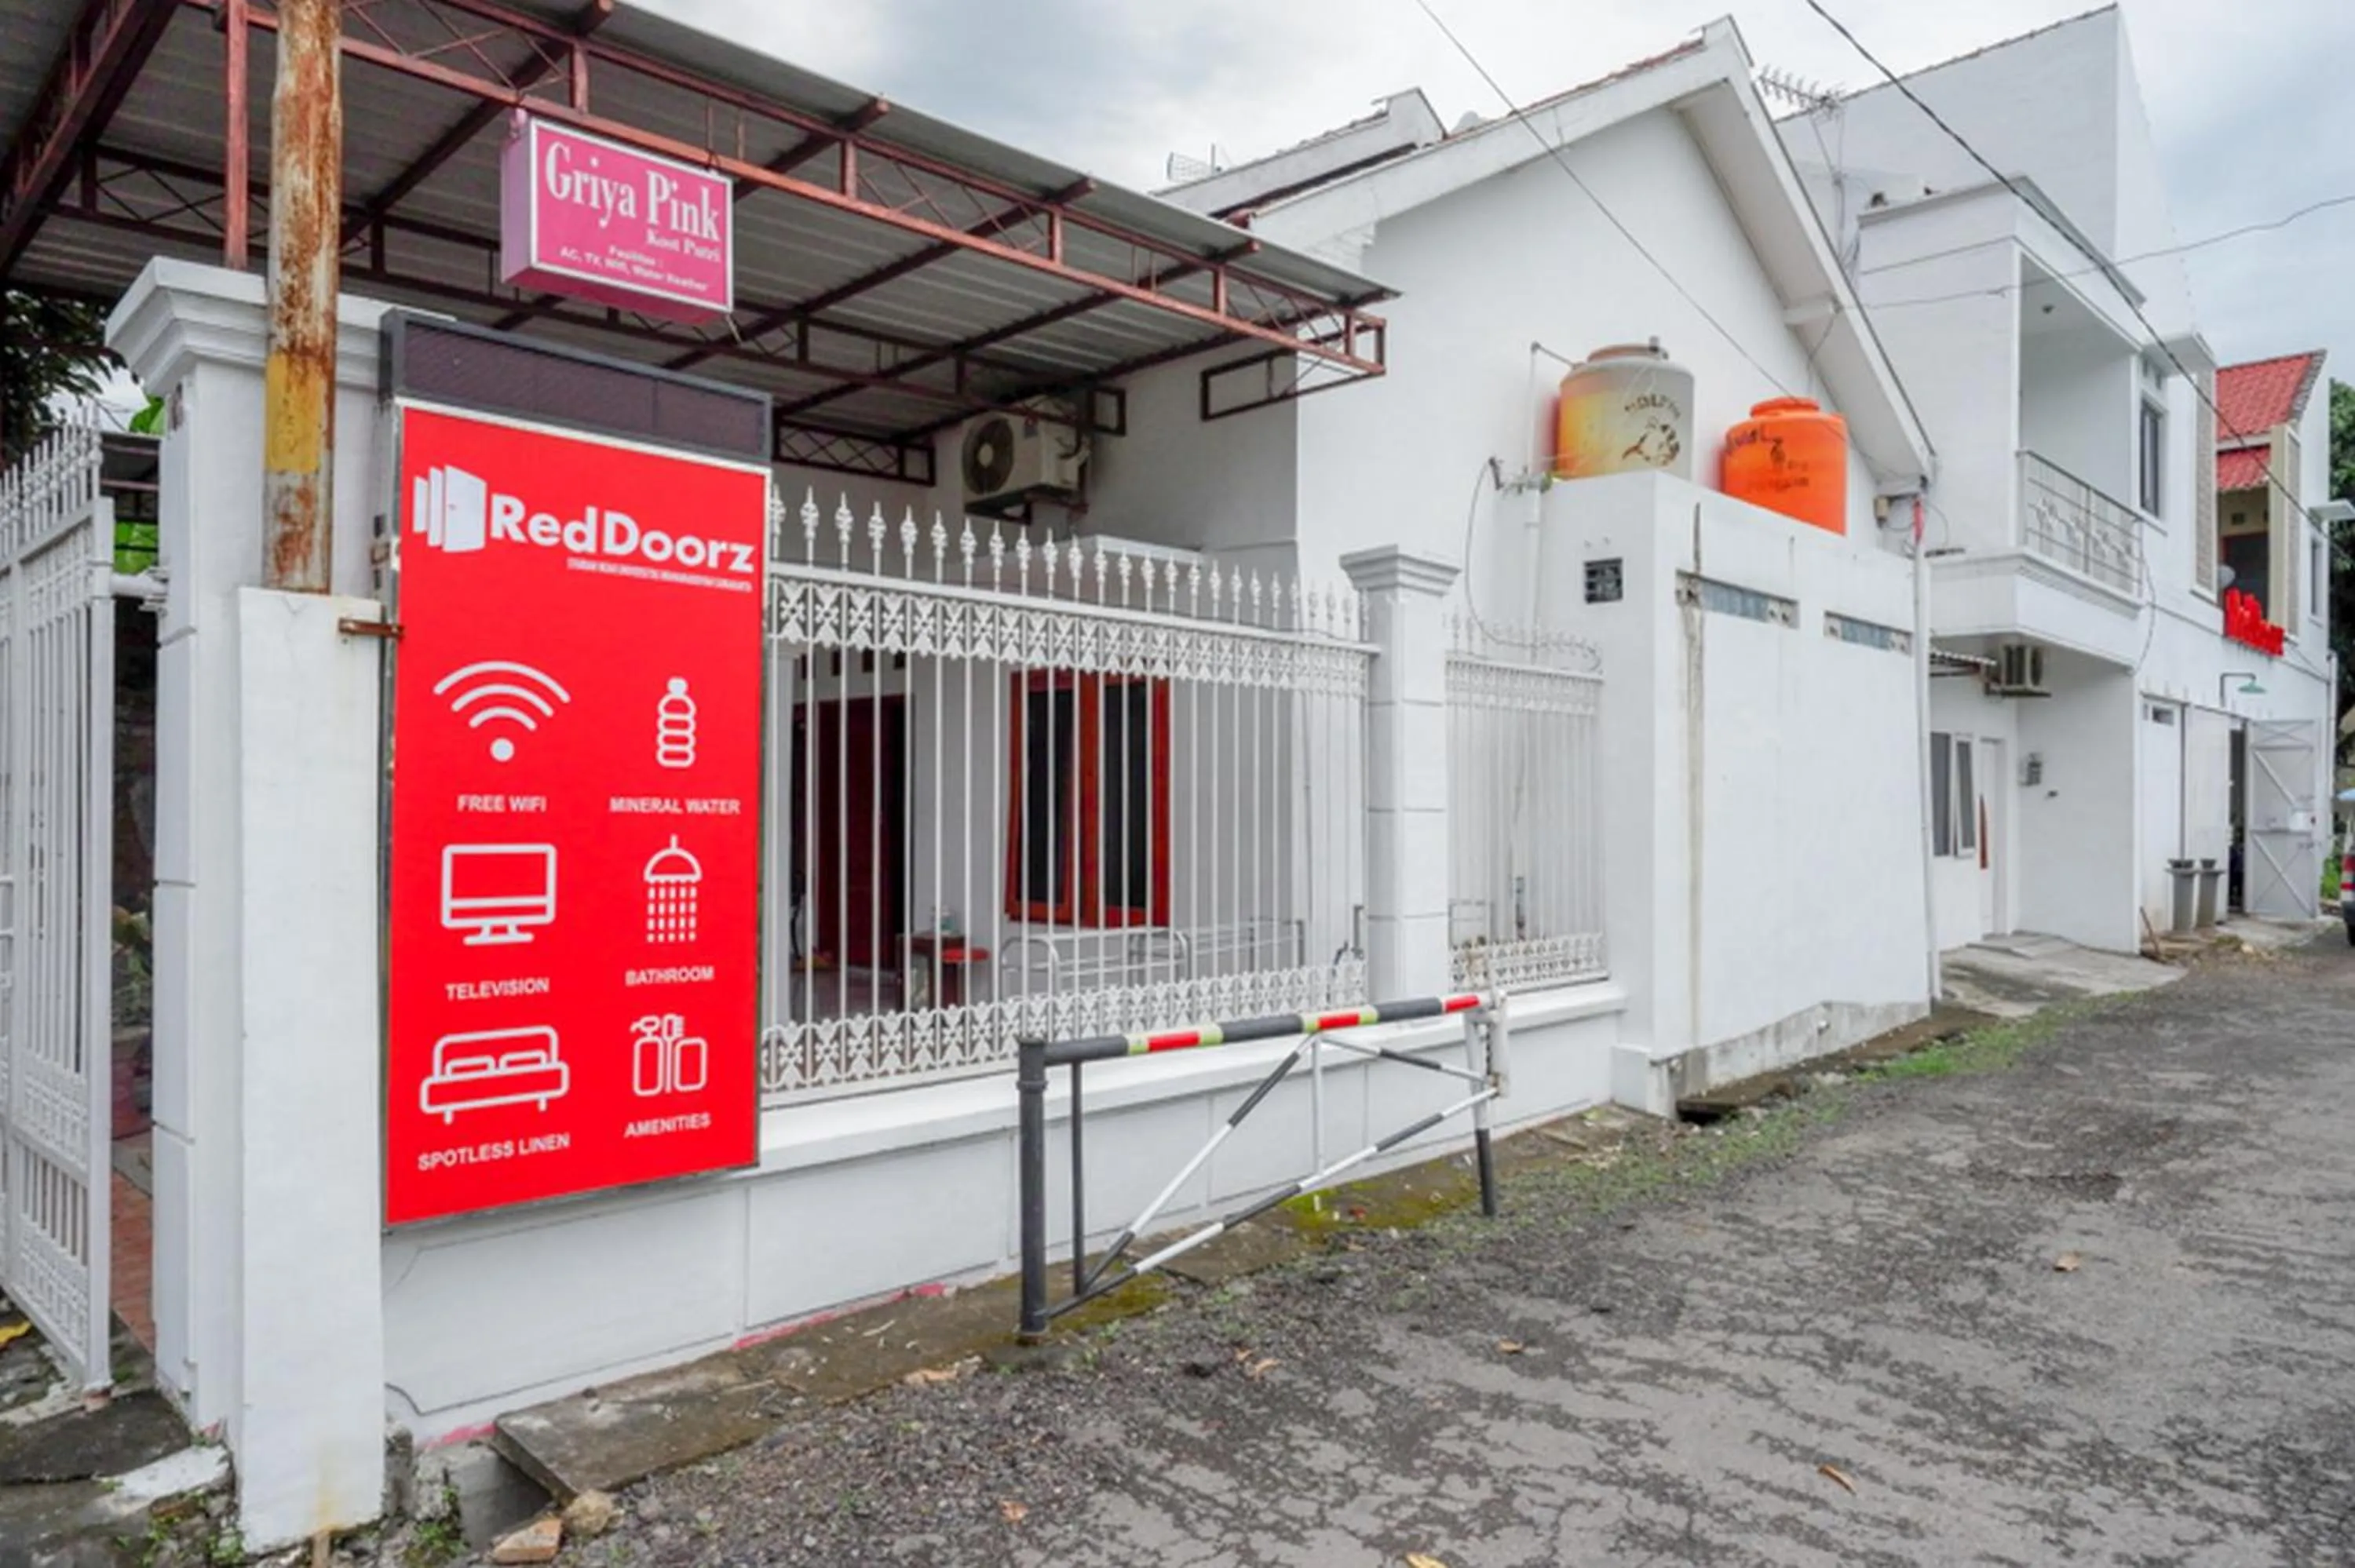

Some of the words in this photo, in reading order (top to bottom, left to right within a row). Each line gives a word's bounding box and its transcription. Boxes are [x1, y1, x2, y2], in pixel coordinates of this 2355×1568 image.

[546, 141, 637, 228] Griya
[646, 170, 720, 241] Pink
[491, 494, 754, 573] RedDoorz
[458, 795, 506, 812] FREE
[509, 795, 546, 811] WIFI
[609, 797, 681, 814] MINERAL
[685, 797, 741, 814] WATER
[626, 966, 714, 986] BATHROOM
[445, 977, 550, 1001] TELEVISION
[624, 1112, 711, 1138] AMENITIES
[418, 1140, 514, 1171] SPOTLESS
[519, 1132, 571, 1156] LINEN
